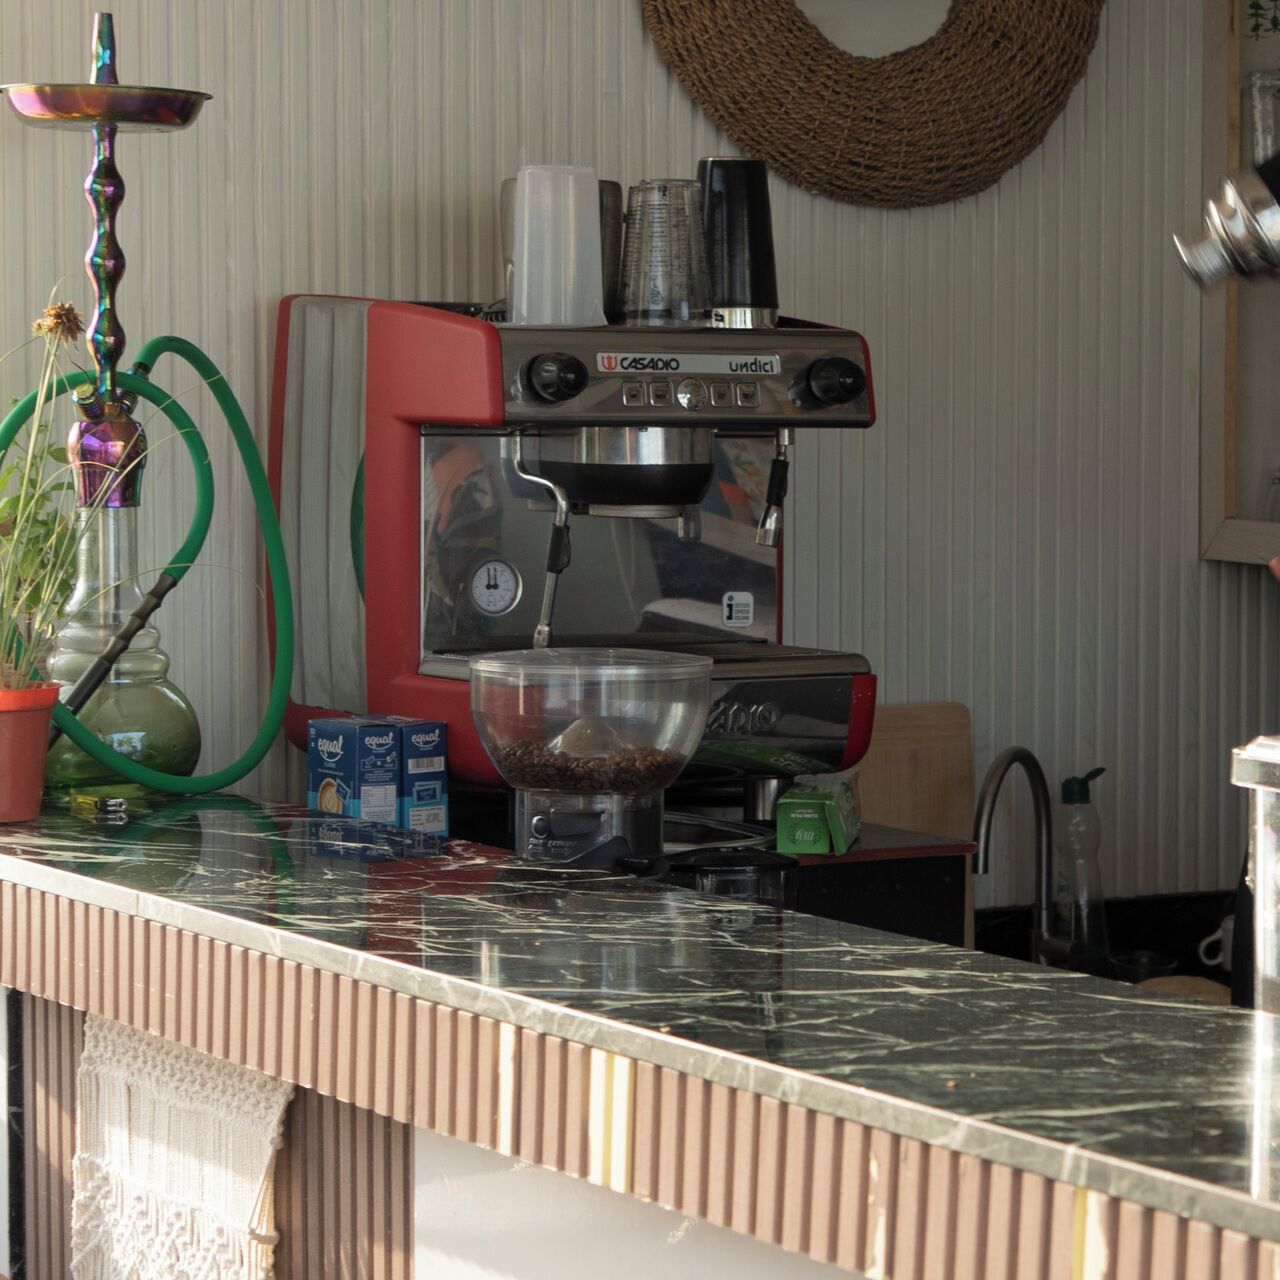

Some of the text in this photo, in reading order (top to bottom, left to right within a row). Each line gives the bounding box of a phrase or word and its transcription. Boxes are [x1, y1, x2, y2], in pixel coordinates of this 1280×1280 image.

[620, 357, 776, 374] CASADIO undici
[706, 702, 783, 734] ADIO
[317, 735, 345, 757] equal
[364, 732, 395, 748] equal
[410, 729, 442, 746] equal
